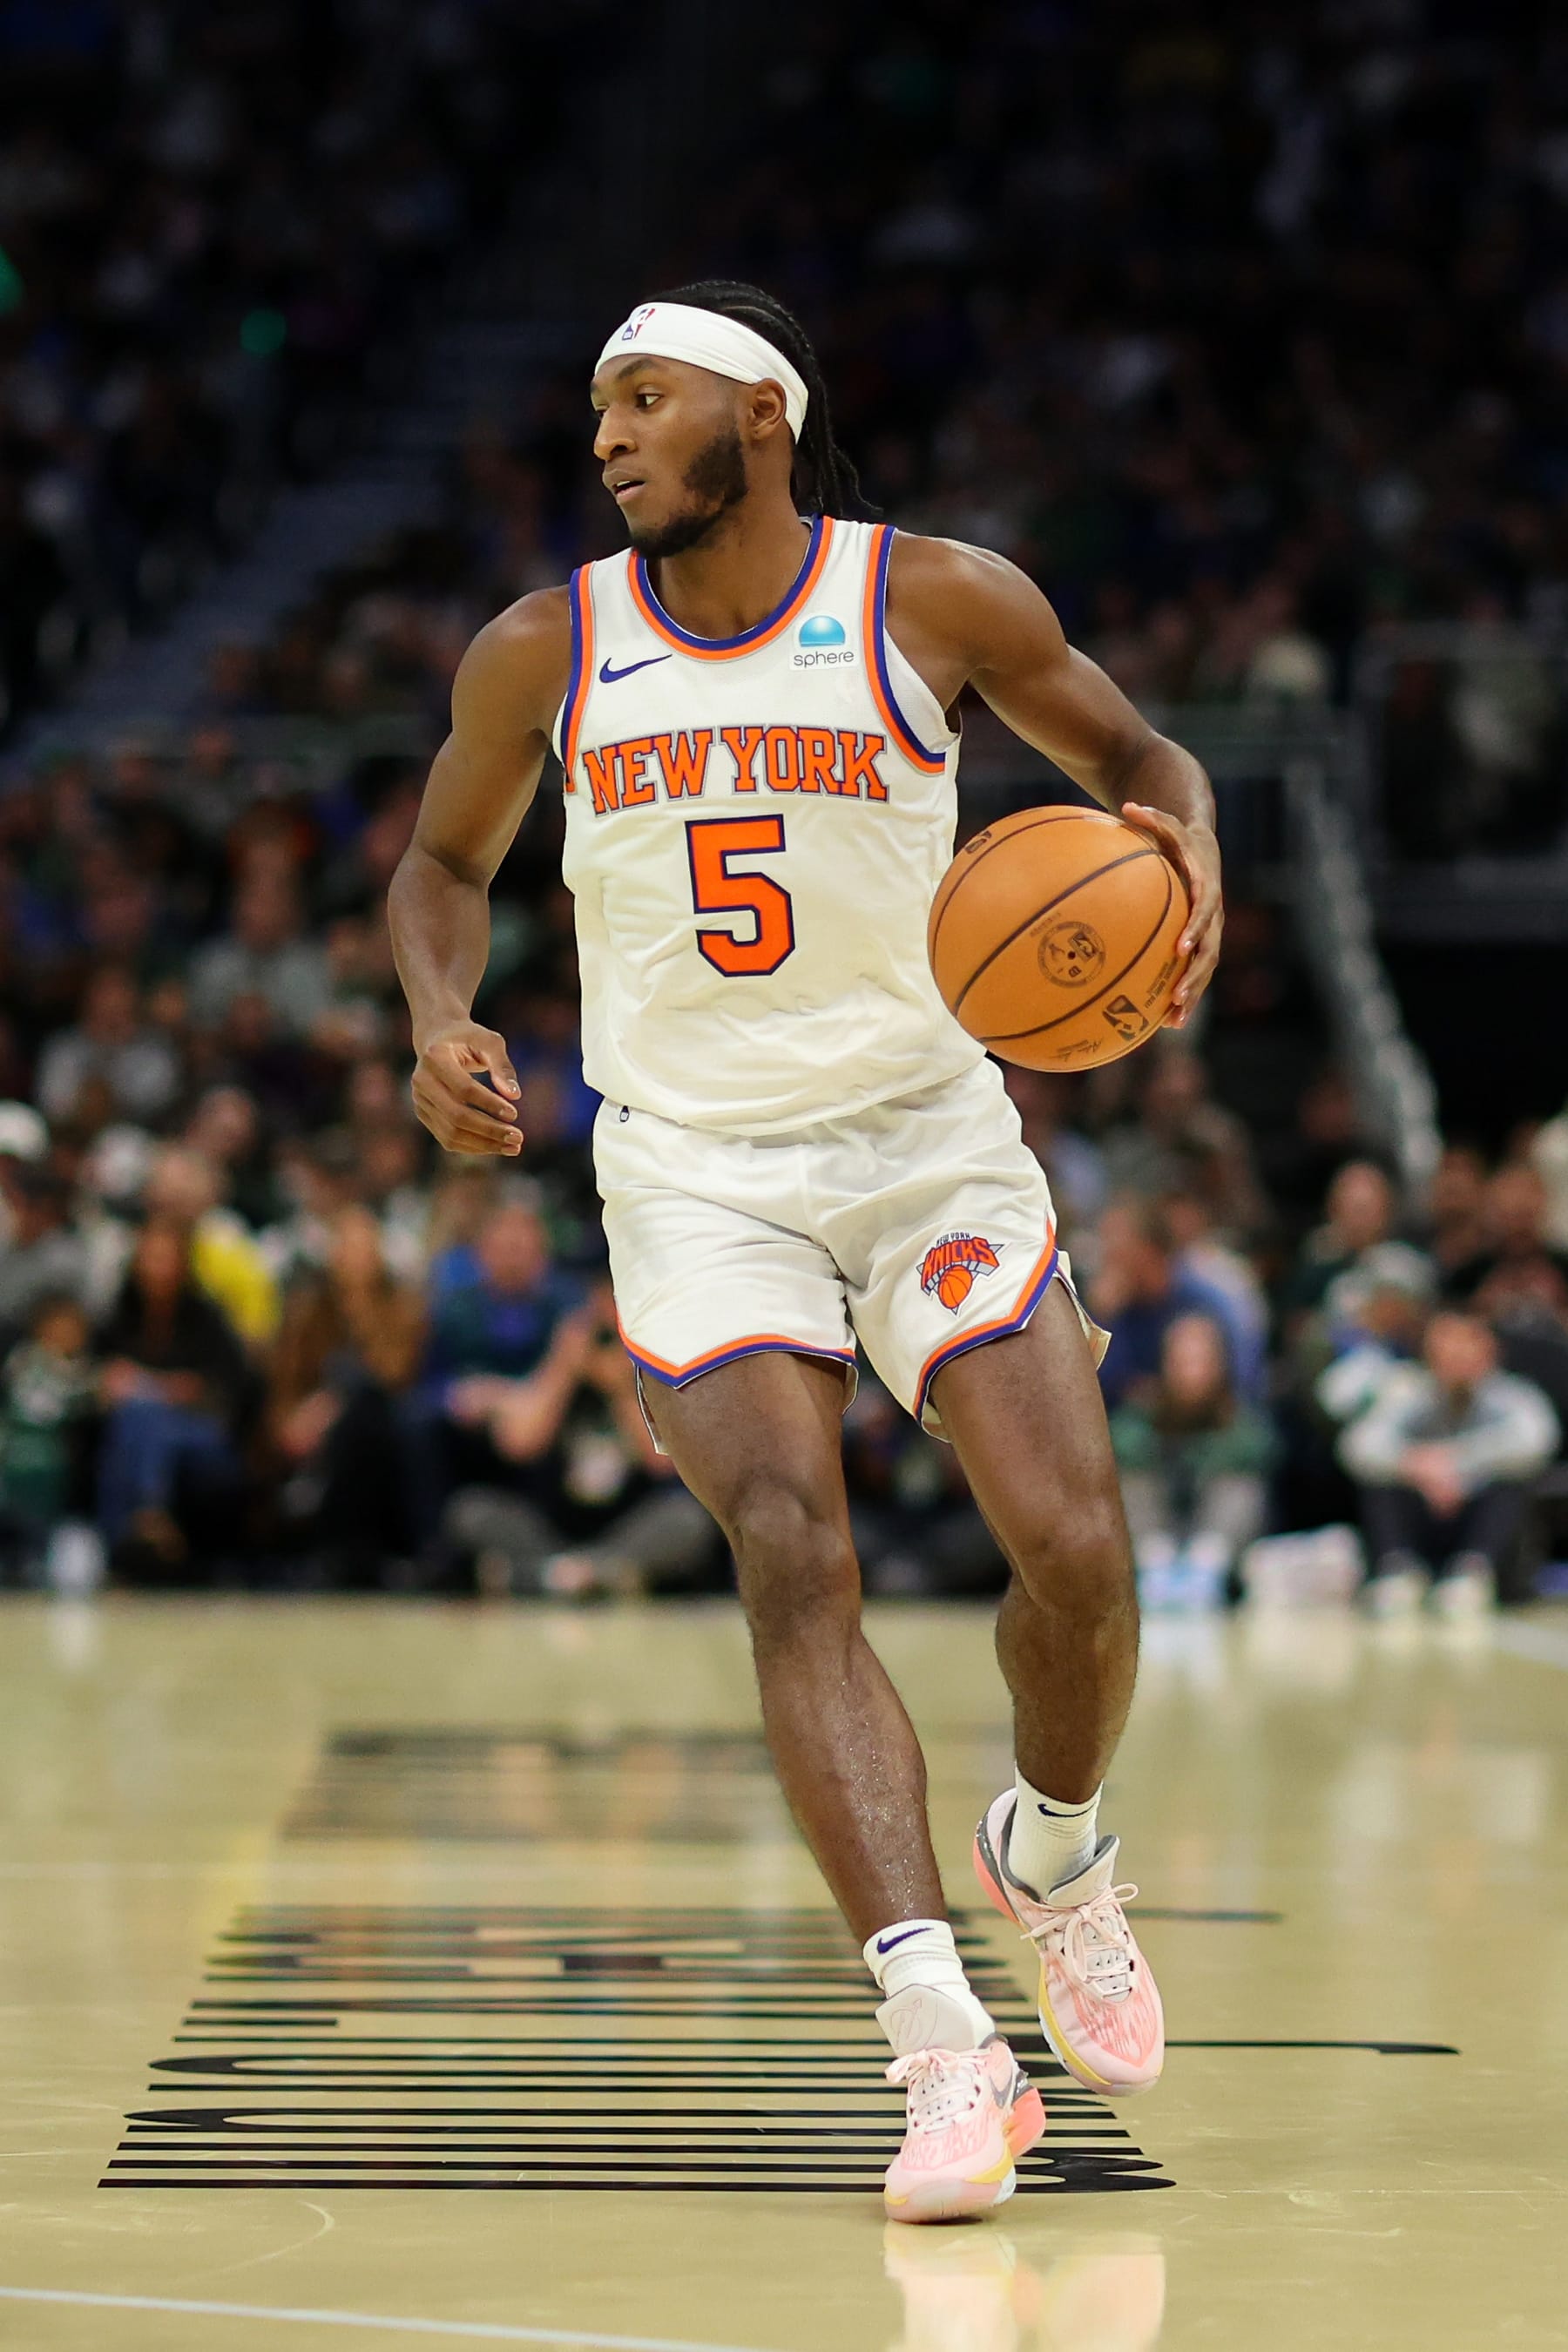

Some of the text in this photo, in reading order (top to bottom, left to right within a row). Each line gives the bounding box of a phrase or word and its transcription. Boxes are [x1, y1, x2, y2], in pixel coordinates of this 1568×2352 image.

[794, 651, 855, 668] sphere
[582, 724, 889, 817] NEW YORK
[685, 814, 795, 977] 5
[921, 1236, 1000, 1290] KNICKS
